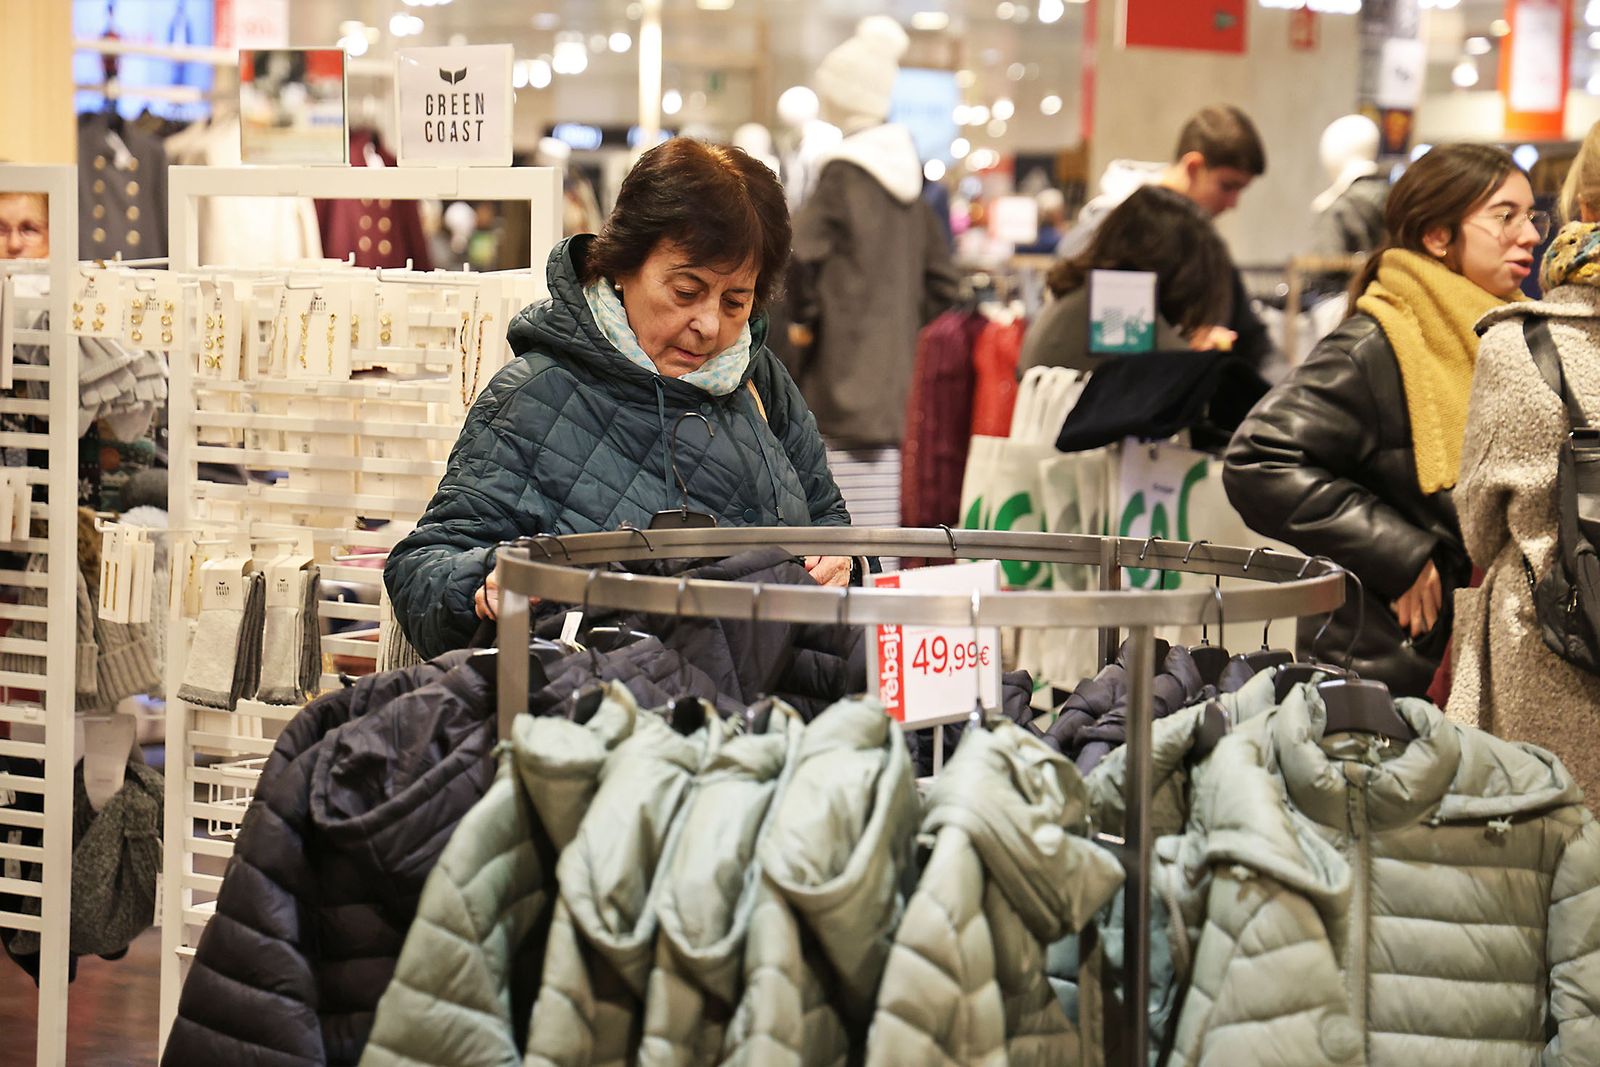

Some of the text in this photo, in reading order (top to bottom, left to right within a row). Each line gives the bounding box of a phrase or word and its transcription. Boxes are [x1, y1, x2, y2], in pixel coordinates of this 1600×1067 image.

[425, 92, 484, 116] GREEN
[424, 120, 484, 143] COAST
[880, 623, 900, 708] rebaja
[912, 635, 990, 677] 49,99€
